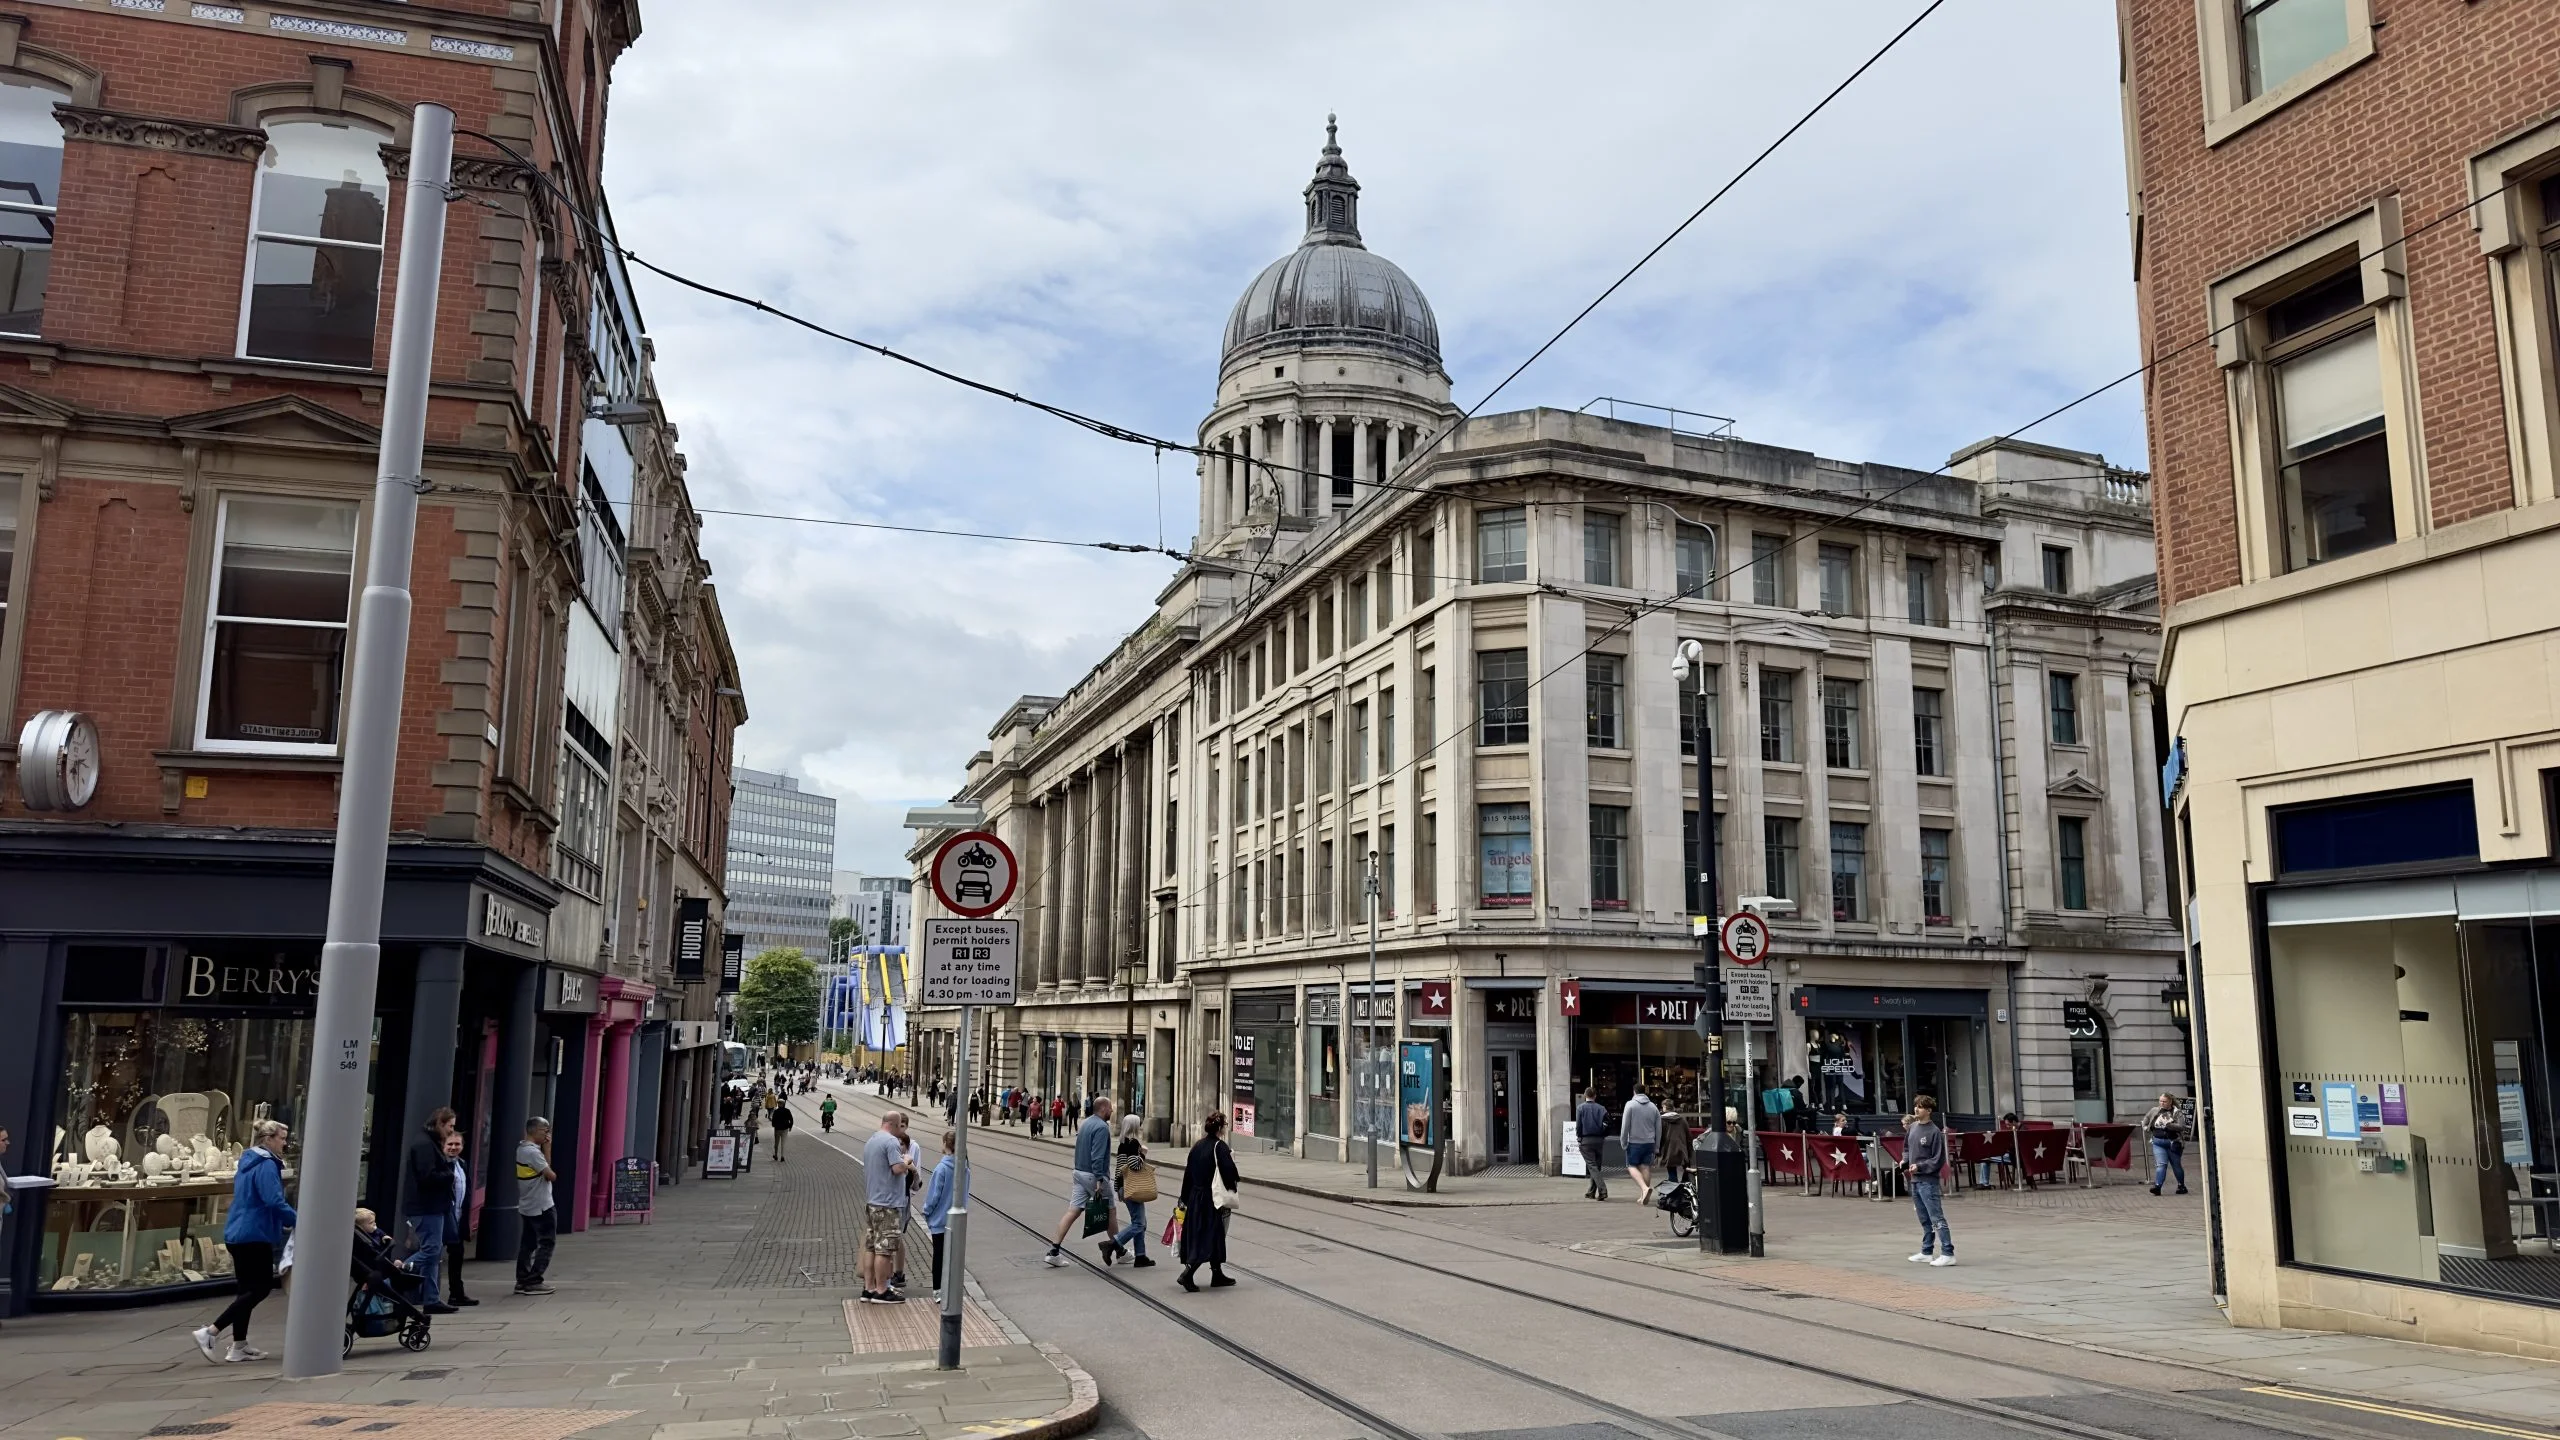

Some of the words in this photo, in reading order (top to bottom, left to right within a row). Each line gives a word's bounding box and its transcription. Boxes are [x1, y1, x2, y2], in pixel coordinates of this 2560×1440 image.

[1490, 852, 1532, 869] angels
[936, 925, 971, 935] Except
[682, 918, 703, 959] HUDDL
[933, 936, 967, 945] permit
[971, 936, 1010, 945] holders
[954, 949, 968, 958] R1
[974, 949, 989, 958] R3
[724, 948, 740, 978] HUDDL
[940, 963, 951, 971] at
[955, 963, 973, 972] any
[977, 963, 1000, 971] time
[186, 956, 321, 997] BERRY'S
[930, 976, 948, 985] and
[953, 976, 967, 985] for
[971, 976, 1010, 986] loading
[927, 990, 954, 998] 4.30
[956, 991, 972, 1000] pm
[981, 990, 993, 998] 10
[1661, 1000, 1688, 1020] PRET
[343, 1040, 358, 1049] LM
[1235, 1036, 1242, 1050] TO
[1244, 1036, 1254, 1050] LET
[344, 1051, 355, 1059] 11
[340, 1062, 357, 1070] 549
[1403, 1061, 1416, 1074] ICED
[1403, 1075, 1420, 1088] LATTE
